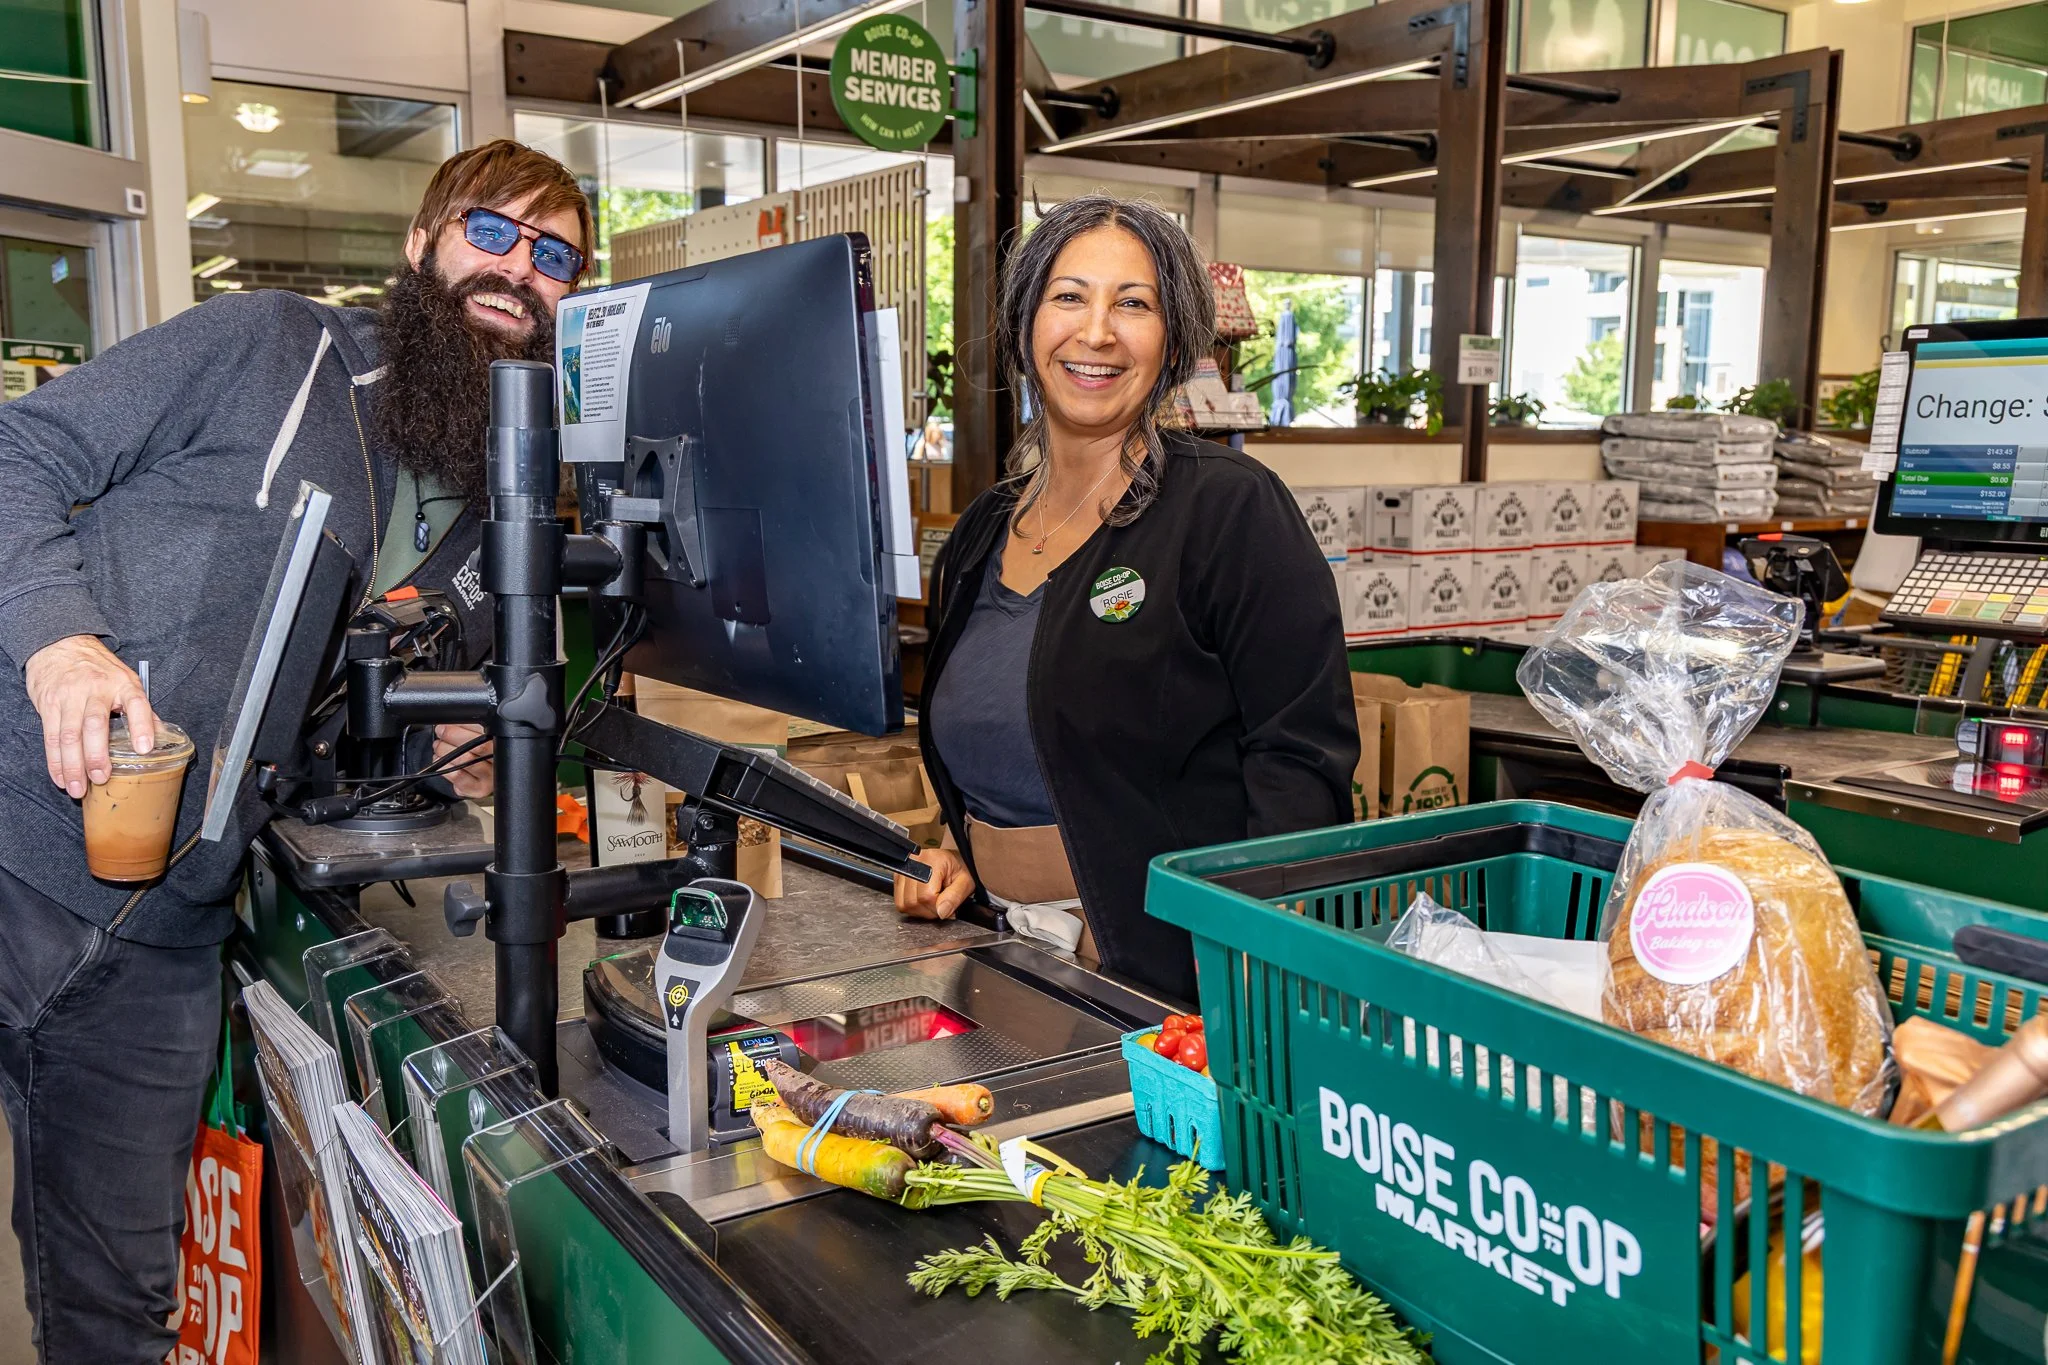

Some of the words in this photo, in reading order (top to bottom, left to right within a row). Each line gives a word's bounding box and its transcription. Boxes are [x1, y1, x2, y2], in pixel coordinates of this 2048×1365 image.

[864, 24, 892, 43] BOISE
[895, 25, 925, 48] CO-OP
[850, 48, 937, 85] MEMBER
[844, 76, 942, 113] SERVICES
[878, 126, 895, 139] CAN
[897, 130, 902, 139] I
[902, 121, 925, 139] HELP?
[1916, 394, 2033, 425] Change:
[1986, 448, 2013, 456] $143.45
[1901, 474, 1916, 482] Total
[1990, 476, 2009, 484] $0.00
[1899, 488, 1927, 496] Tendered
[1979, 489, 2006, 498] $152.00
[1305, 502, 1338, 526] OUNTAIN
[451, 576, 475, 611] MARKET
[1095, 577, 1113, 590] BOISE
[1102, 589, 1134, 608] ROSIE
[607, 830, 663, 852] SAWTOOTH
[1649, 935, 1701, 954] Baking
[742, 1036, 774, 1047] IDAHO
[724, 1043, 735, 1086] APPROVED
[1319, 1086, 1458, 1216] BOISE
[1542, 1202, 1561, 1222] 19
[1375, 1183, 1576, 1307] MARKET
[1543, 1234, 1564, 1255] 73
